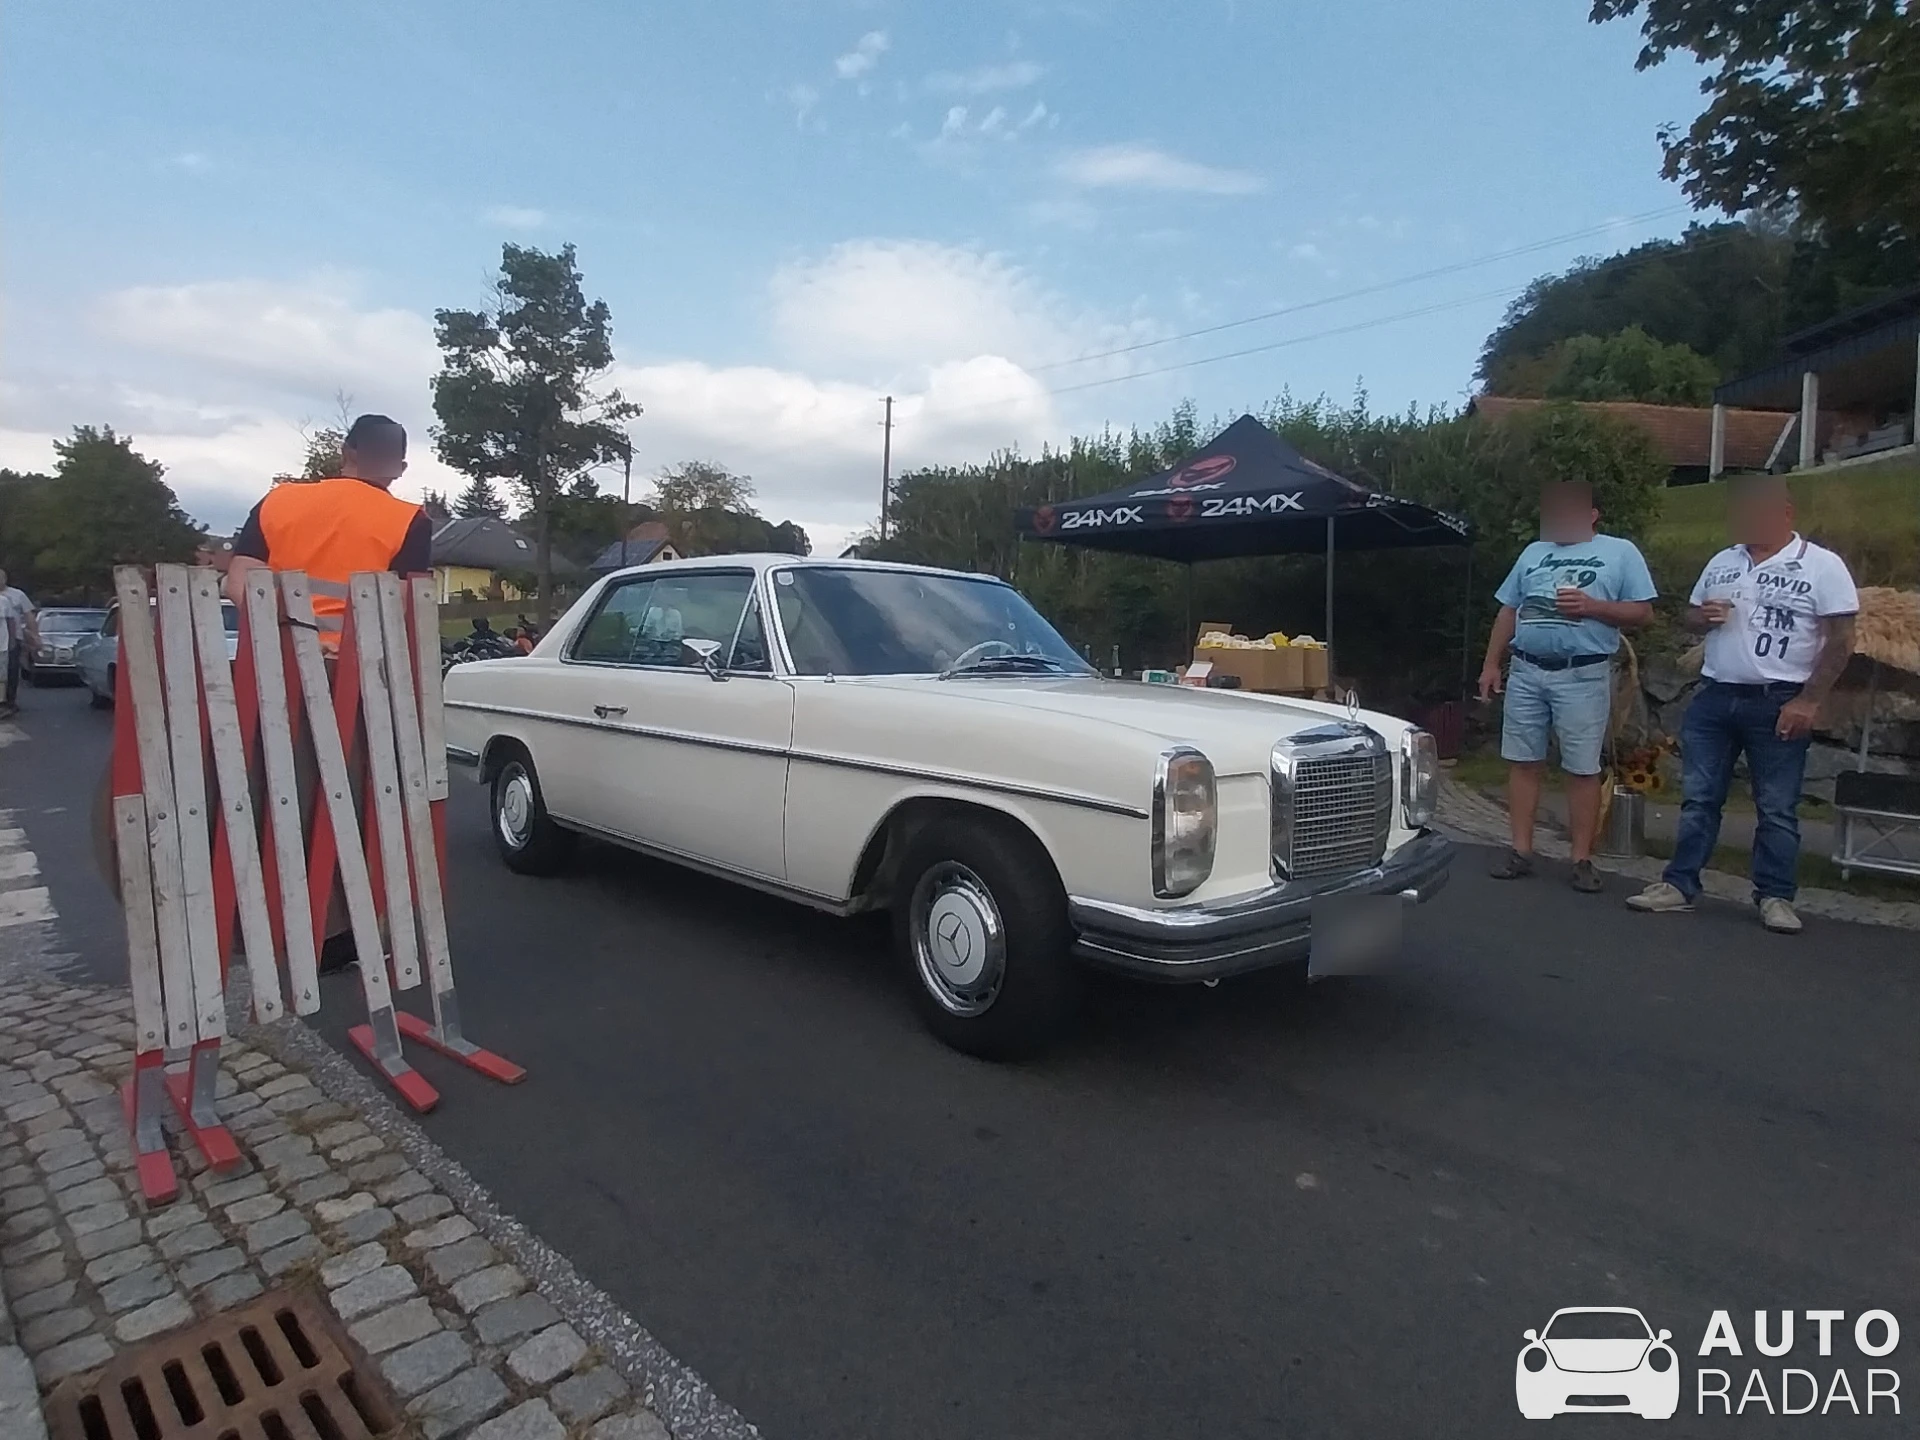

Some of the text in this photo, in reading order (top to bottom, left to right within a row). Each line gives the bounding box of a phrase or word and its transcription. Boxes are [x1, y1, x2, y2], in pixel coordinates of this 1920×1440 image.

[1061, 491, 1305, 530] 24MX 24MX
[1526, 553, 1605, 573] Impala
[1756, 572, 1812, 594] DAVID
[1754, 632, 1790, 660] 01
